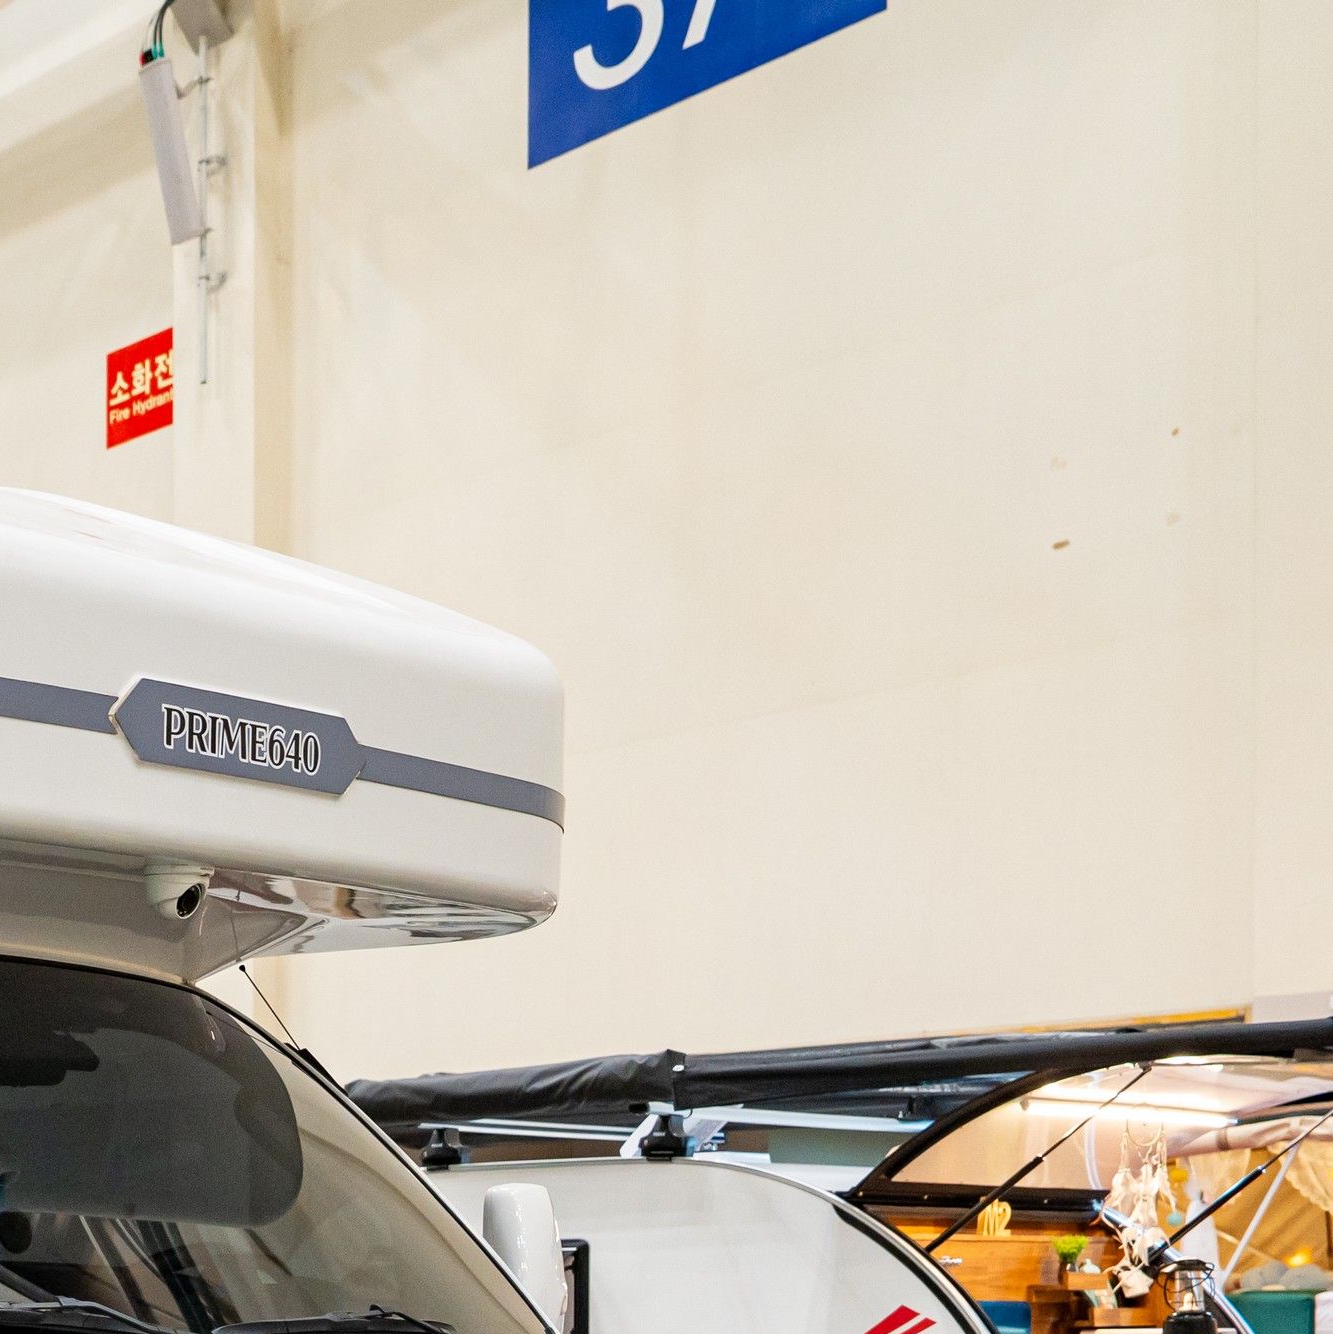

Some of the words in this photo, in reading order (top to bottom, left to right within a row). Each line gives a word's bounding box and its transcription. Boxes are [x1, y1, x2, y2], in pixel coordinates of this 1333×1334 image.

[574, 0, 716, 90] 3
[109, 348, 173, 407] 소화전
[109, 407, 131, 424] Fire
[161, 703, 322, 776] PRIME640
